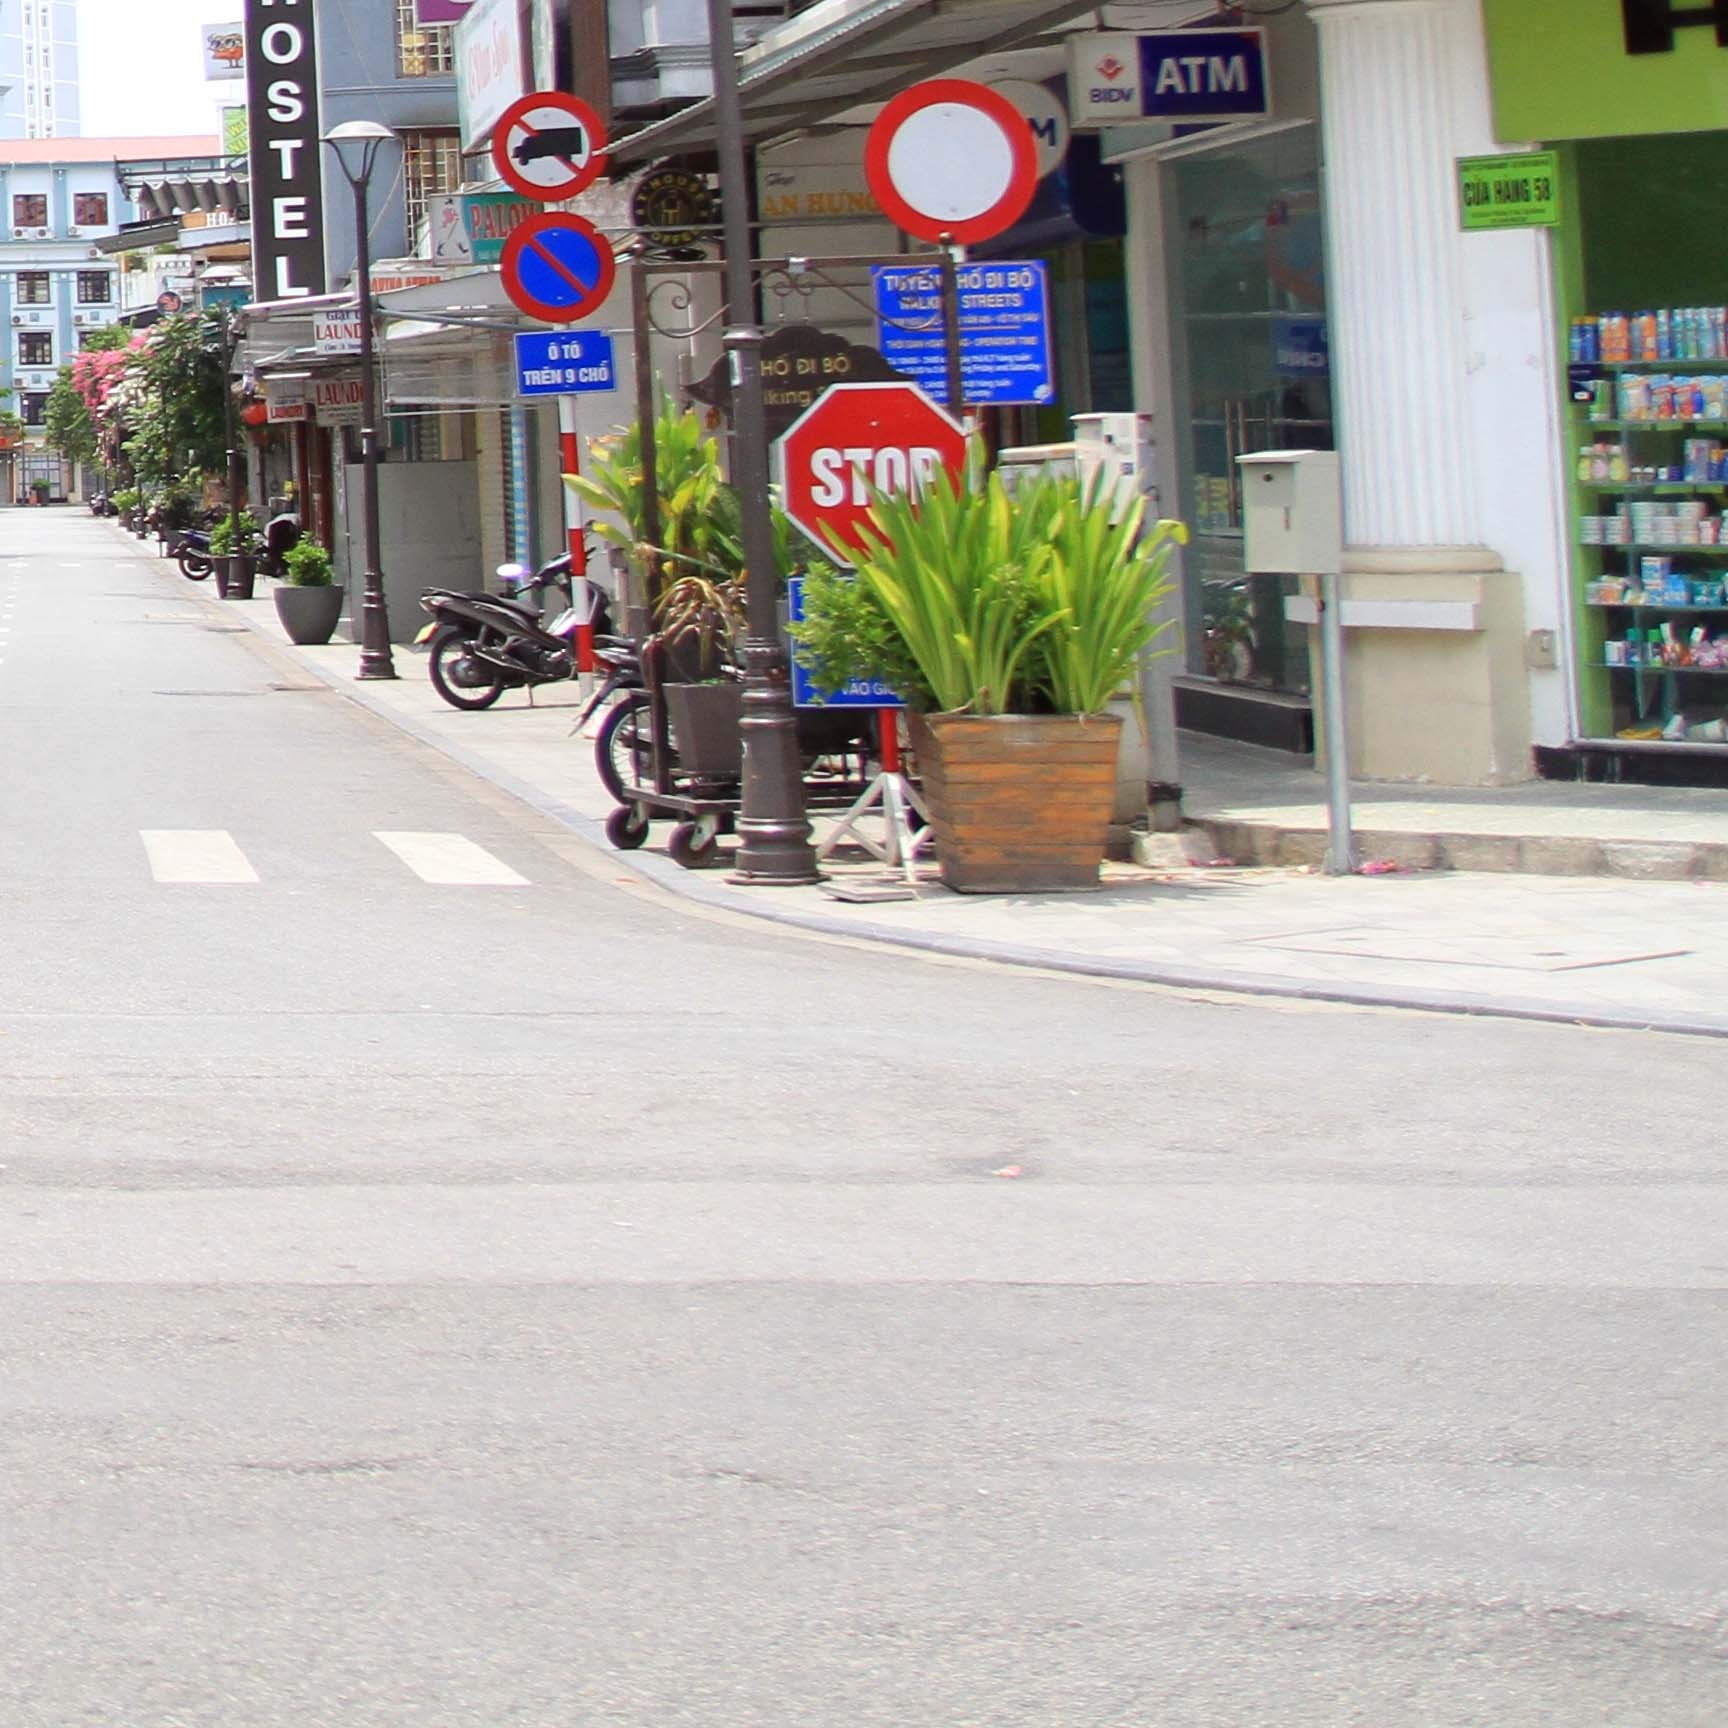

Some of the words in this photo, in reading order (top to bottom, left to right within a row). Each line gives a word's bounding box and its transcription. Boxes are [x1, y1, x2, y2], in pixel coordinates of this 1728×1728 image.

[1155, 56, 1248, 95] ATM
[1090, 87, 1134, 103] BIDV
[955, 267, 983, 290] HỐ
[1008, 267, 1035, 290] BỘ
[960, 293, 1024, 309] STREETS
[562, 341, 580, 360] TÔ
[522, 366, 562, 386] TRÊN
[565, 367, 575, 383] 9
[578, 359, 609, 383] CHỖ
[760, 352, 788, 376] HỐ
[797, 356, 817, 375] ĐI
[810, 446, 944, 508] STOP
